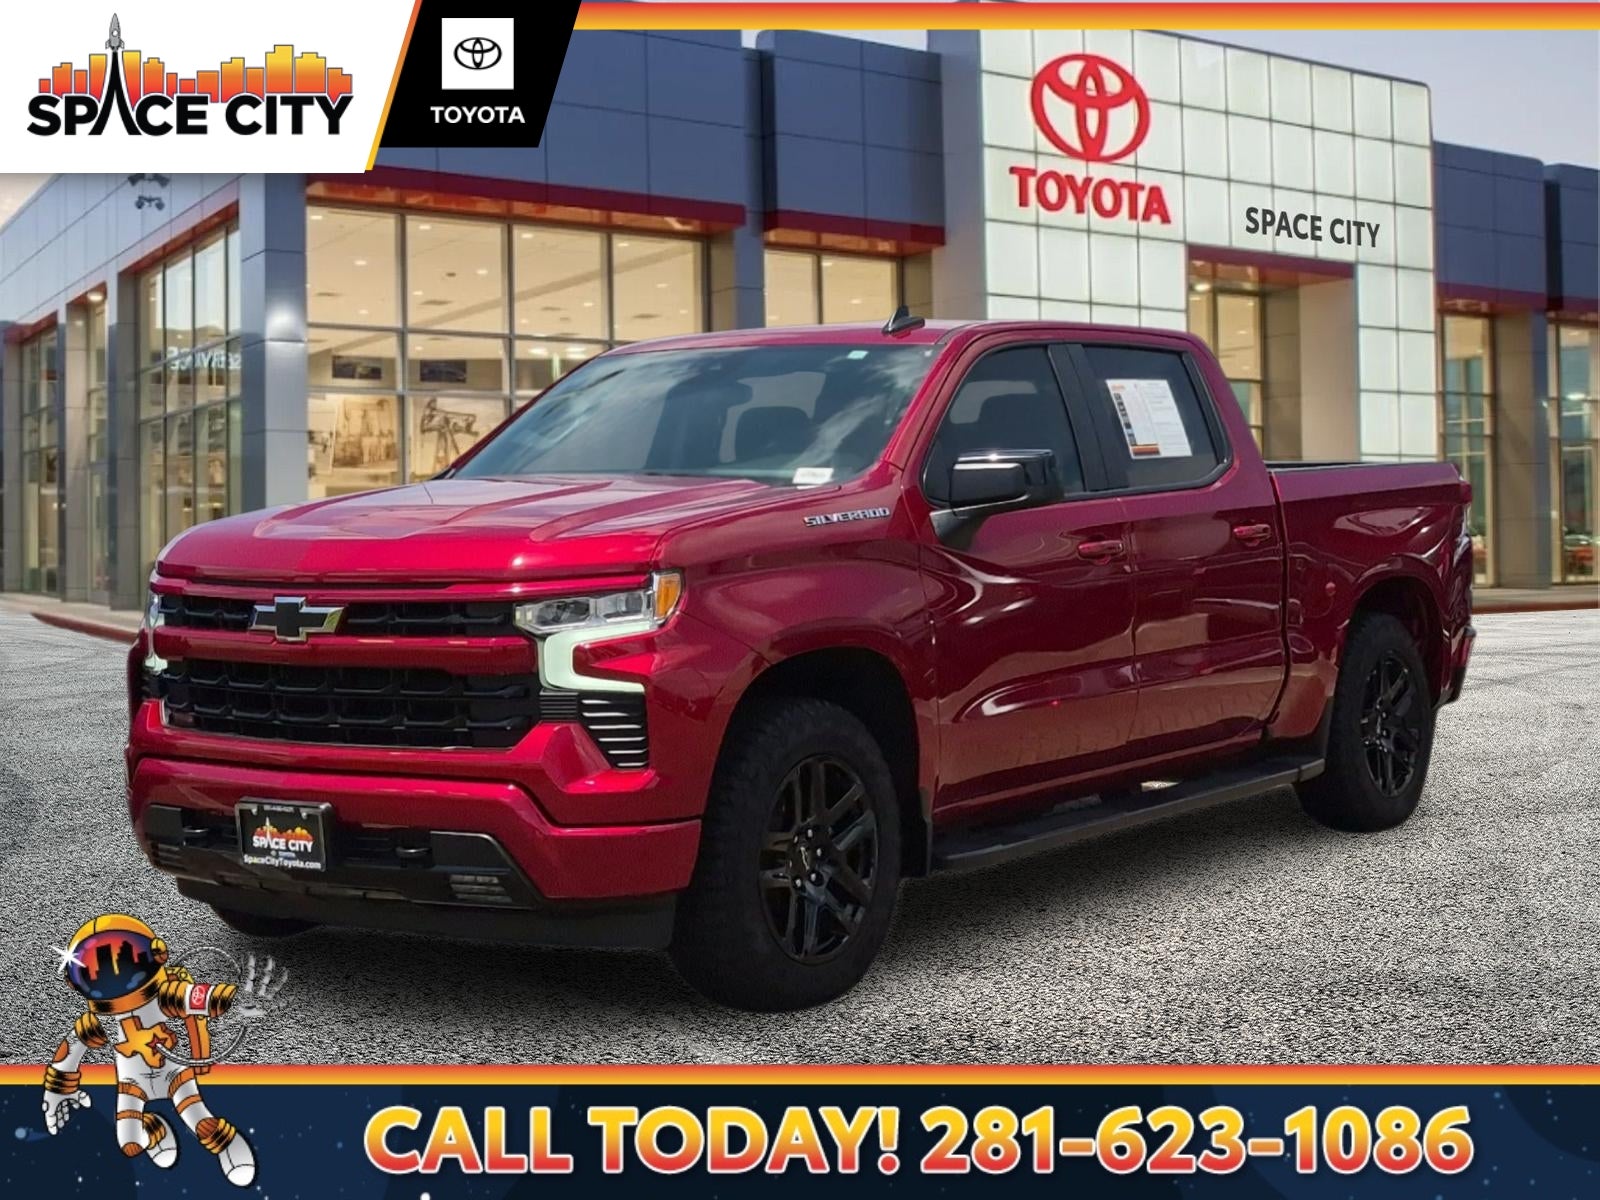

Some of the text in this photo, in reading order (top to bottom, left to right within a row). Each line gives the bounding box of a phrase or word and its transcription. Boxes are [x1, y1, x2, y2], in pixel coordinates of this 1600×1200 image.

[1009, 166, 1171, 224] TOYOTA
[1245, 206, 1381, 248] SPACE CITY
[803, 507, 890, 527] SILVERADO
[252, 835, 314, 852] SPACE CITY
[243, 854, 322, 869] SpaceCityToyota.com
